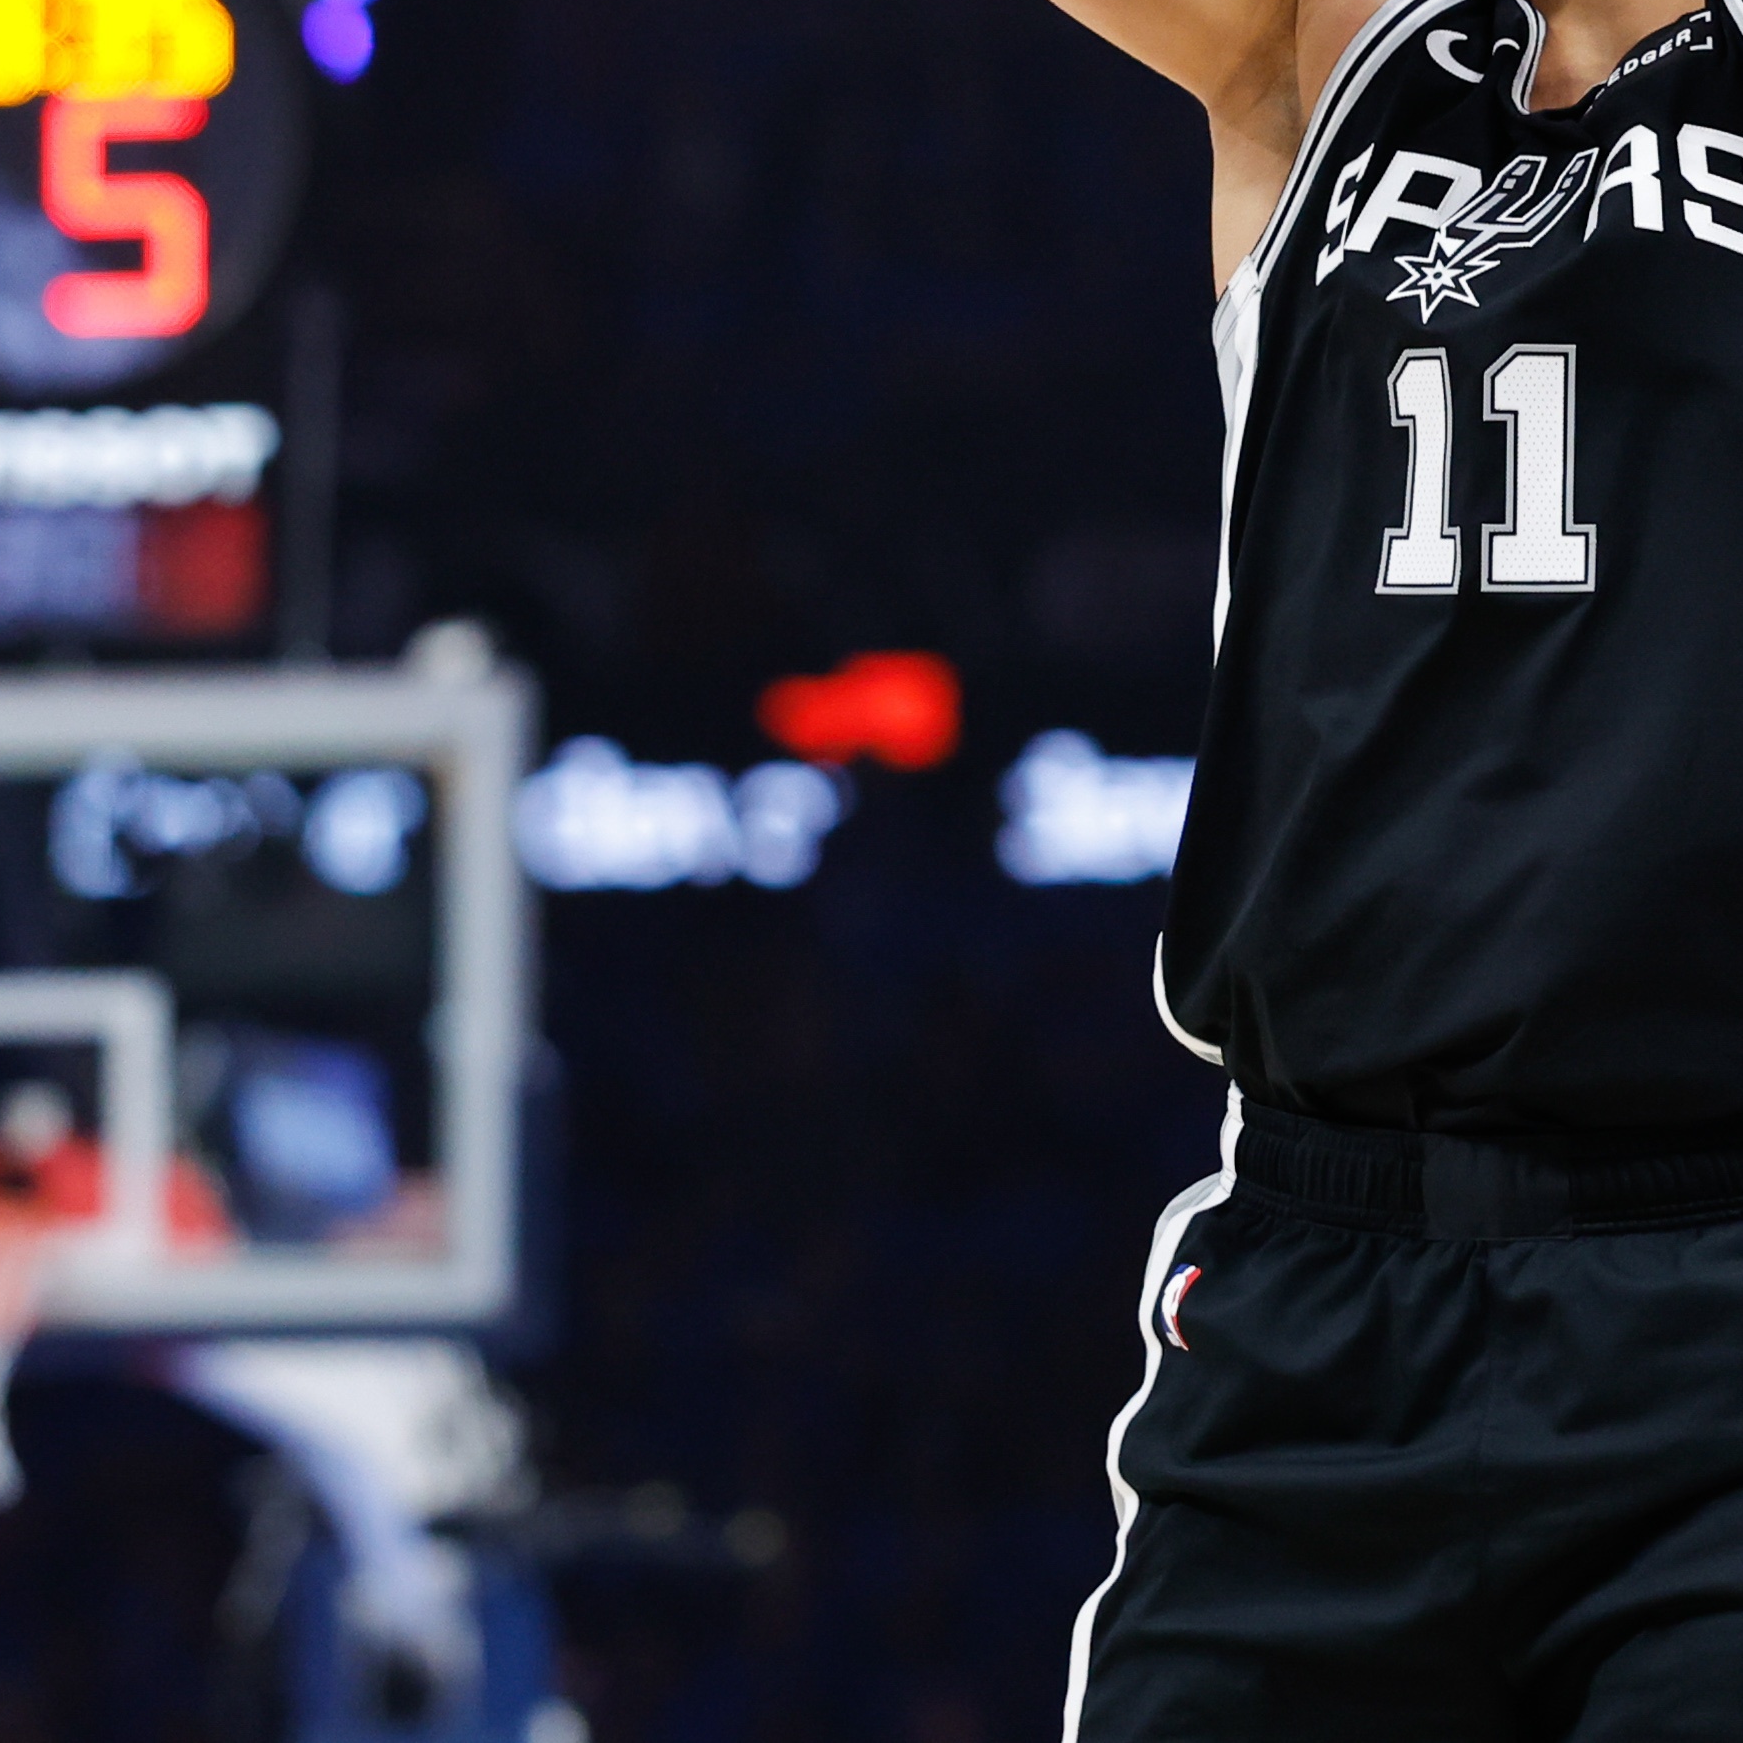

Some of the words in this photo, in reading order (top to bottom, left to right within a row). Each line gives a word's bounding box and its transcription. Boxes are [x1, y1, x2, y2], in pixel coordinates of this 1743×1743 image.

[1595, 28, 1692, 101] EDGER
[41, 93, 210, 339] 5
[1375, 343, 1598, 596] 11
